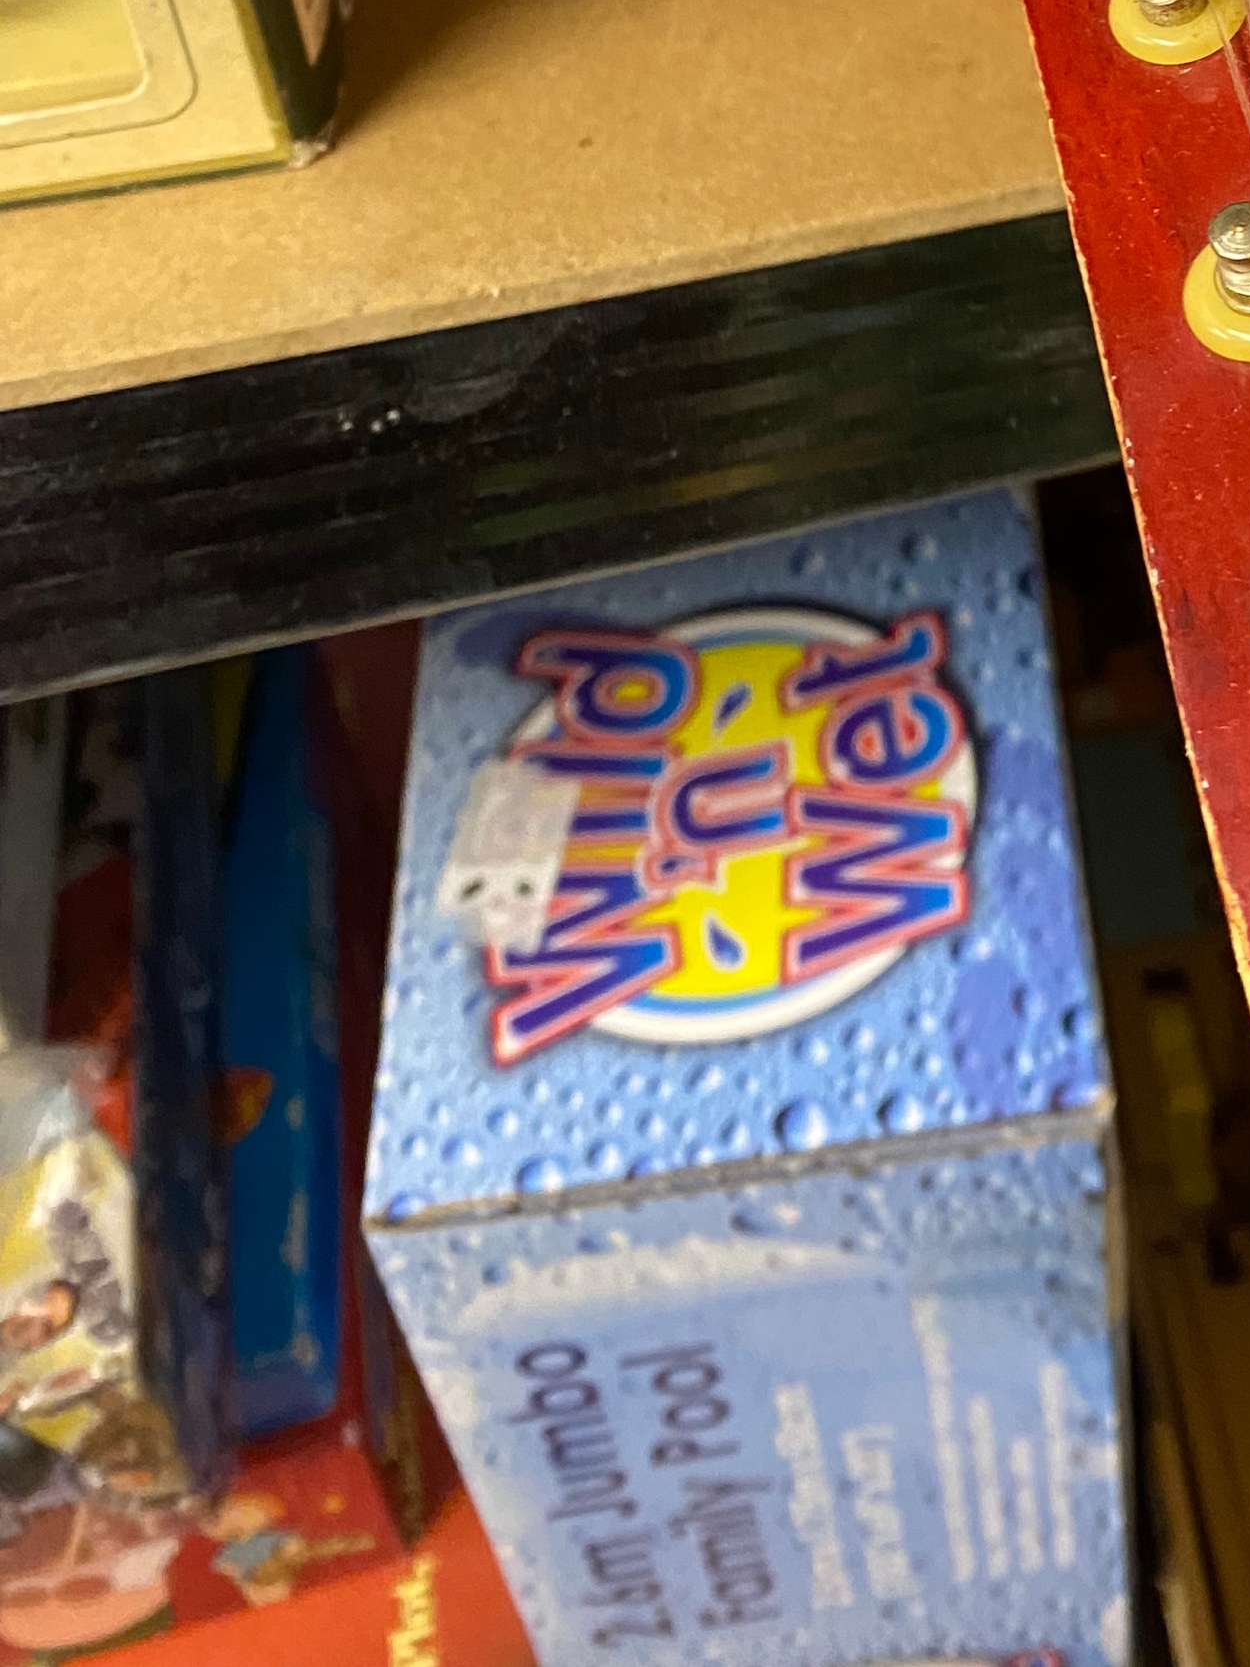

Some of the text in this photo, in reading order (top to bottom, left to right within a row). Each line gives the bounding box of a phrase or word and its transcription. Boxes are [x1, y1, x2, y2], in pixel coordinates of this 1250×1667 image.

[780, 612, 969, 988] Wet
[506, 1341, 675, 1649] 2.6m Jumbo
[618, 1339, 784, 1630] Family Pool
